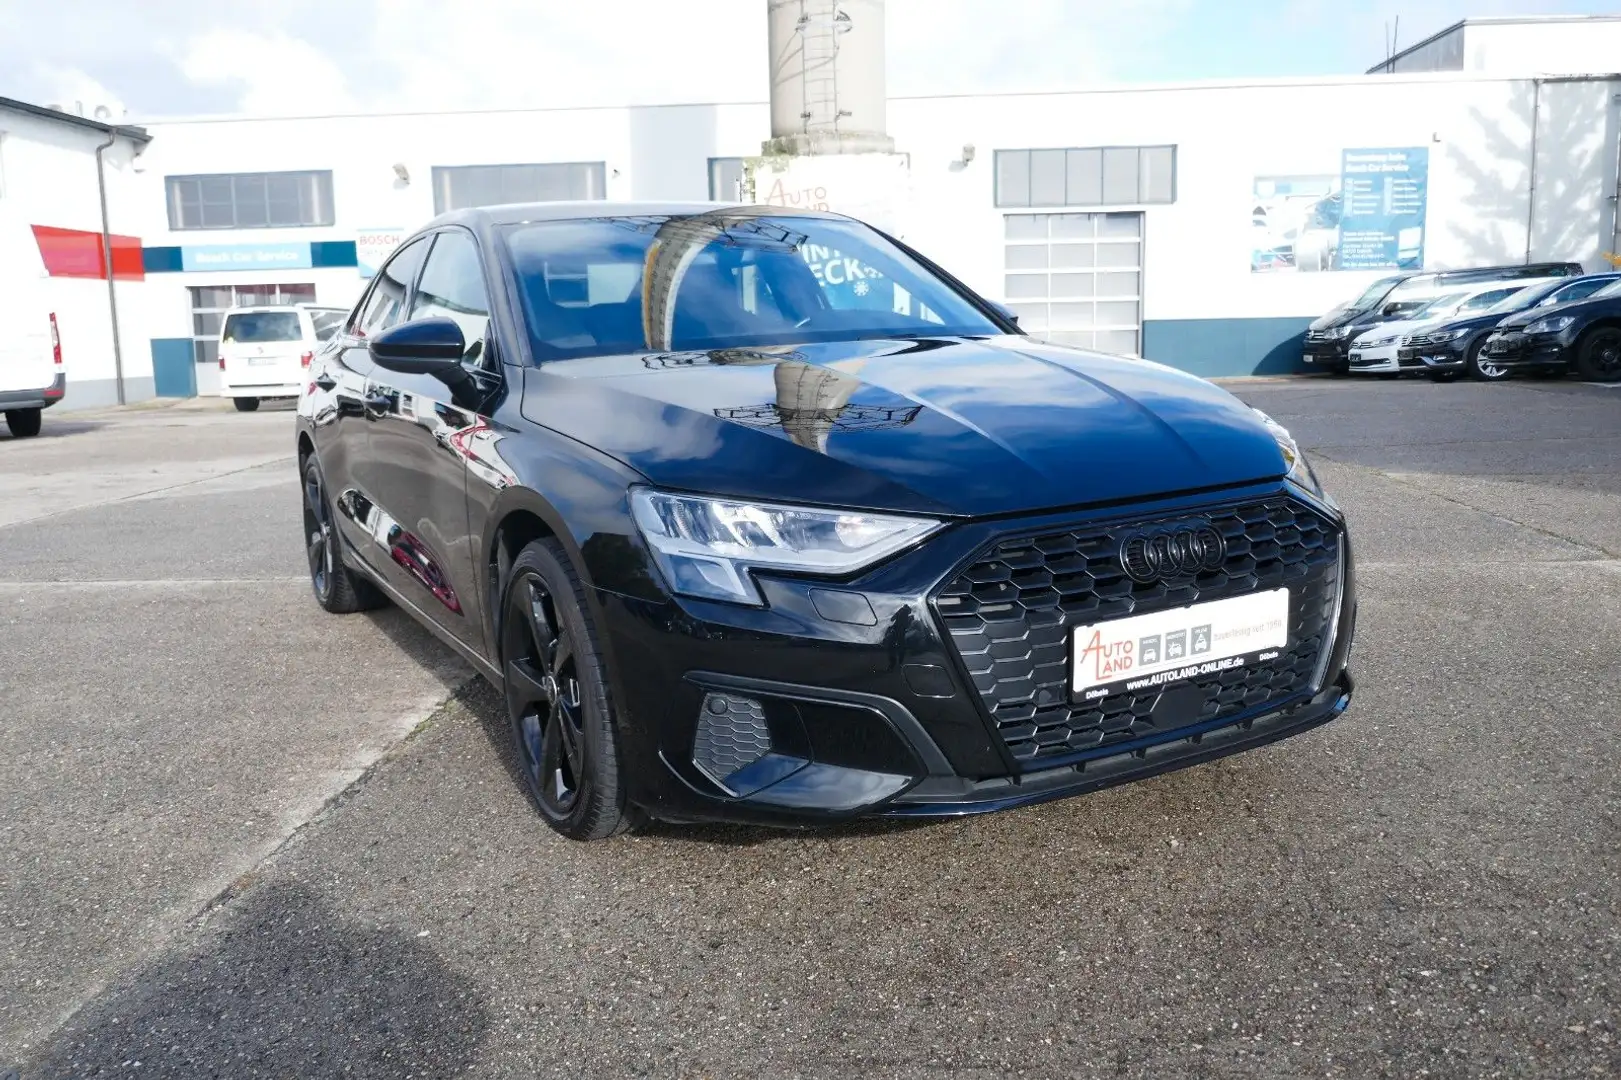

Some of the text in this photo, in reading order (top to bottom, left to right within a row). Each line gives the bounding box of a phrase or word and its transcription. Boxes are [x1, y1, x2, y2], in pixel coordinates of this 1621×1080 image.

[359, 234, 400, 246] BOSCH
[195, 249, 299, 263] Bosch Car Service
[1126, 656, 1245, 690] www.AUTOLAND-ONLINE.de
